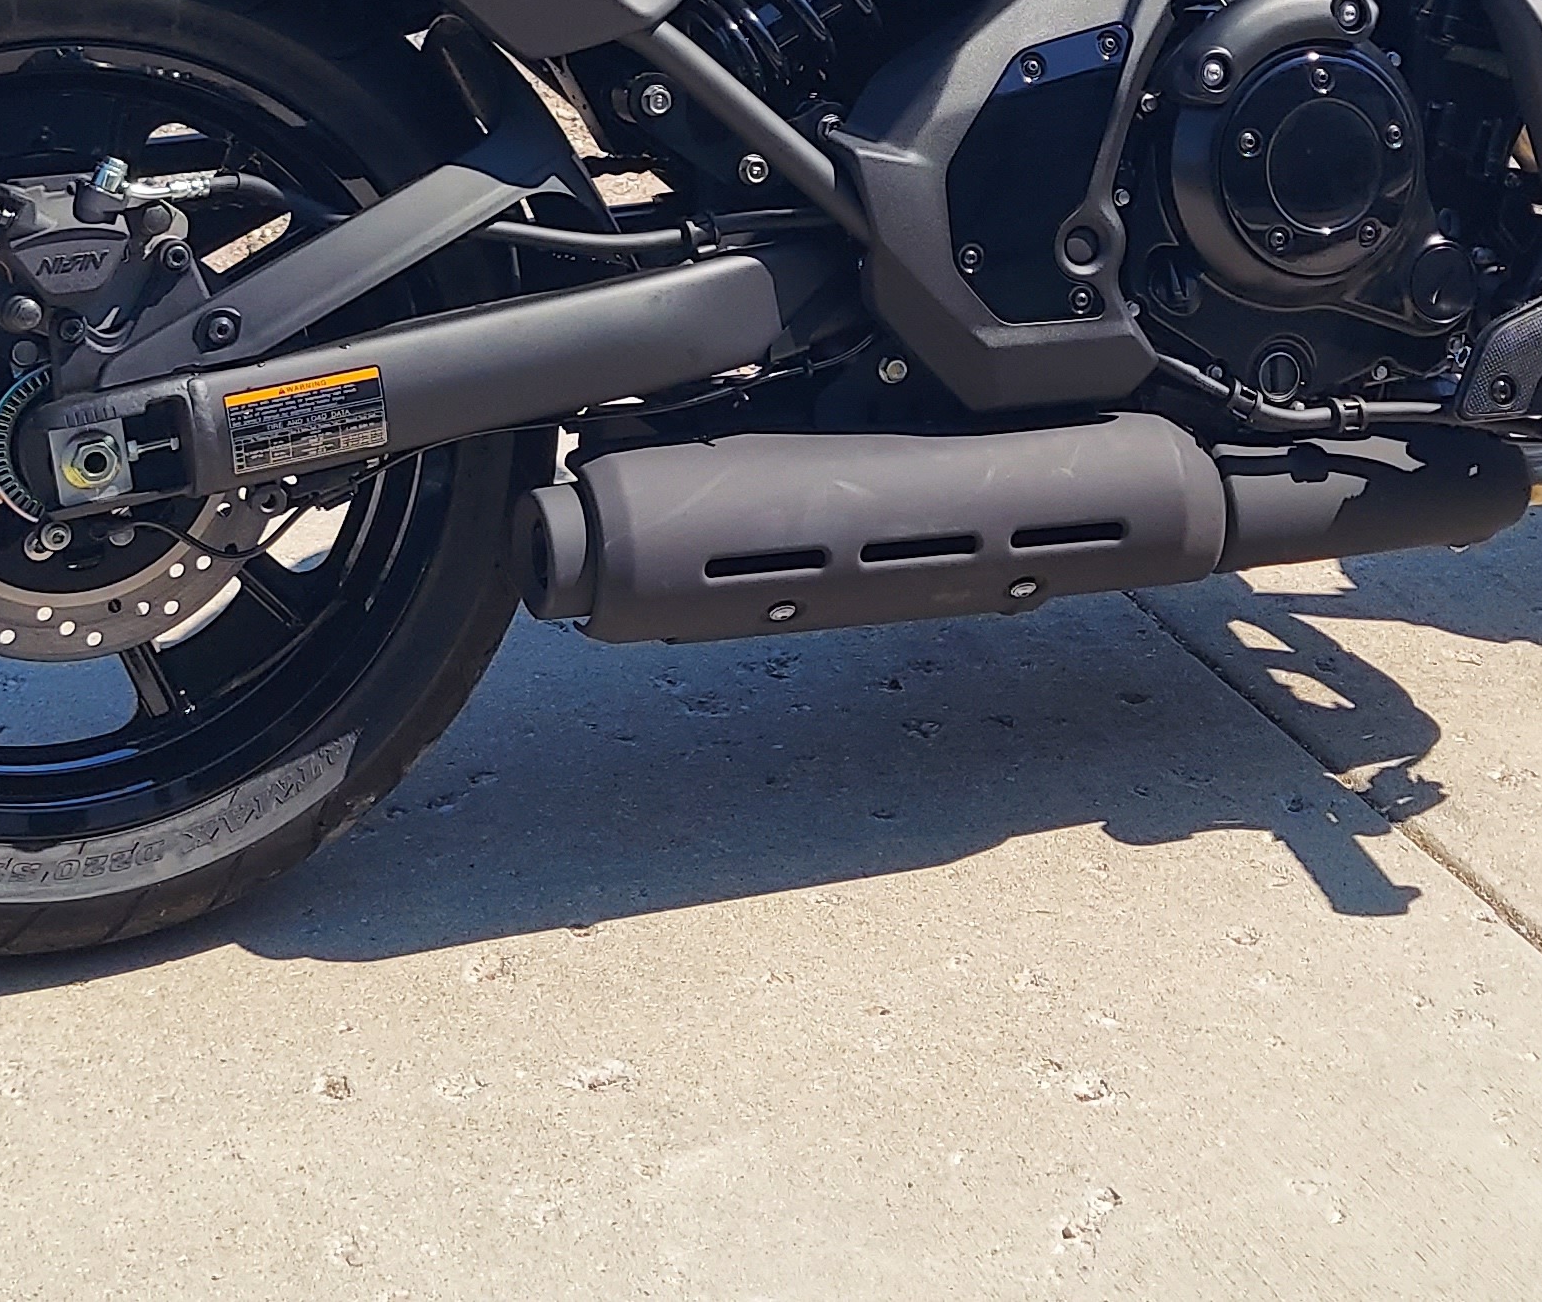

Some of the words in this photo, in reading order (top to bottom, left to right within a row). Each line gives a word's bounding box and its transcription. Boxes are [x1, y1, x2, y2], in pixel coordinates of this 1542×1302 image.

[285, 379, 327, 393] WARNING
[287, 418, 304, 427] AND
[331, 409, 350, 419] DATA
[54, 840, 165, 881] D220
